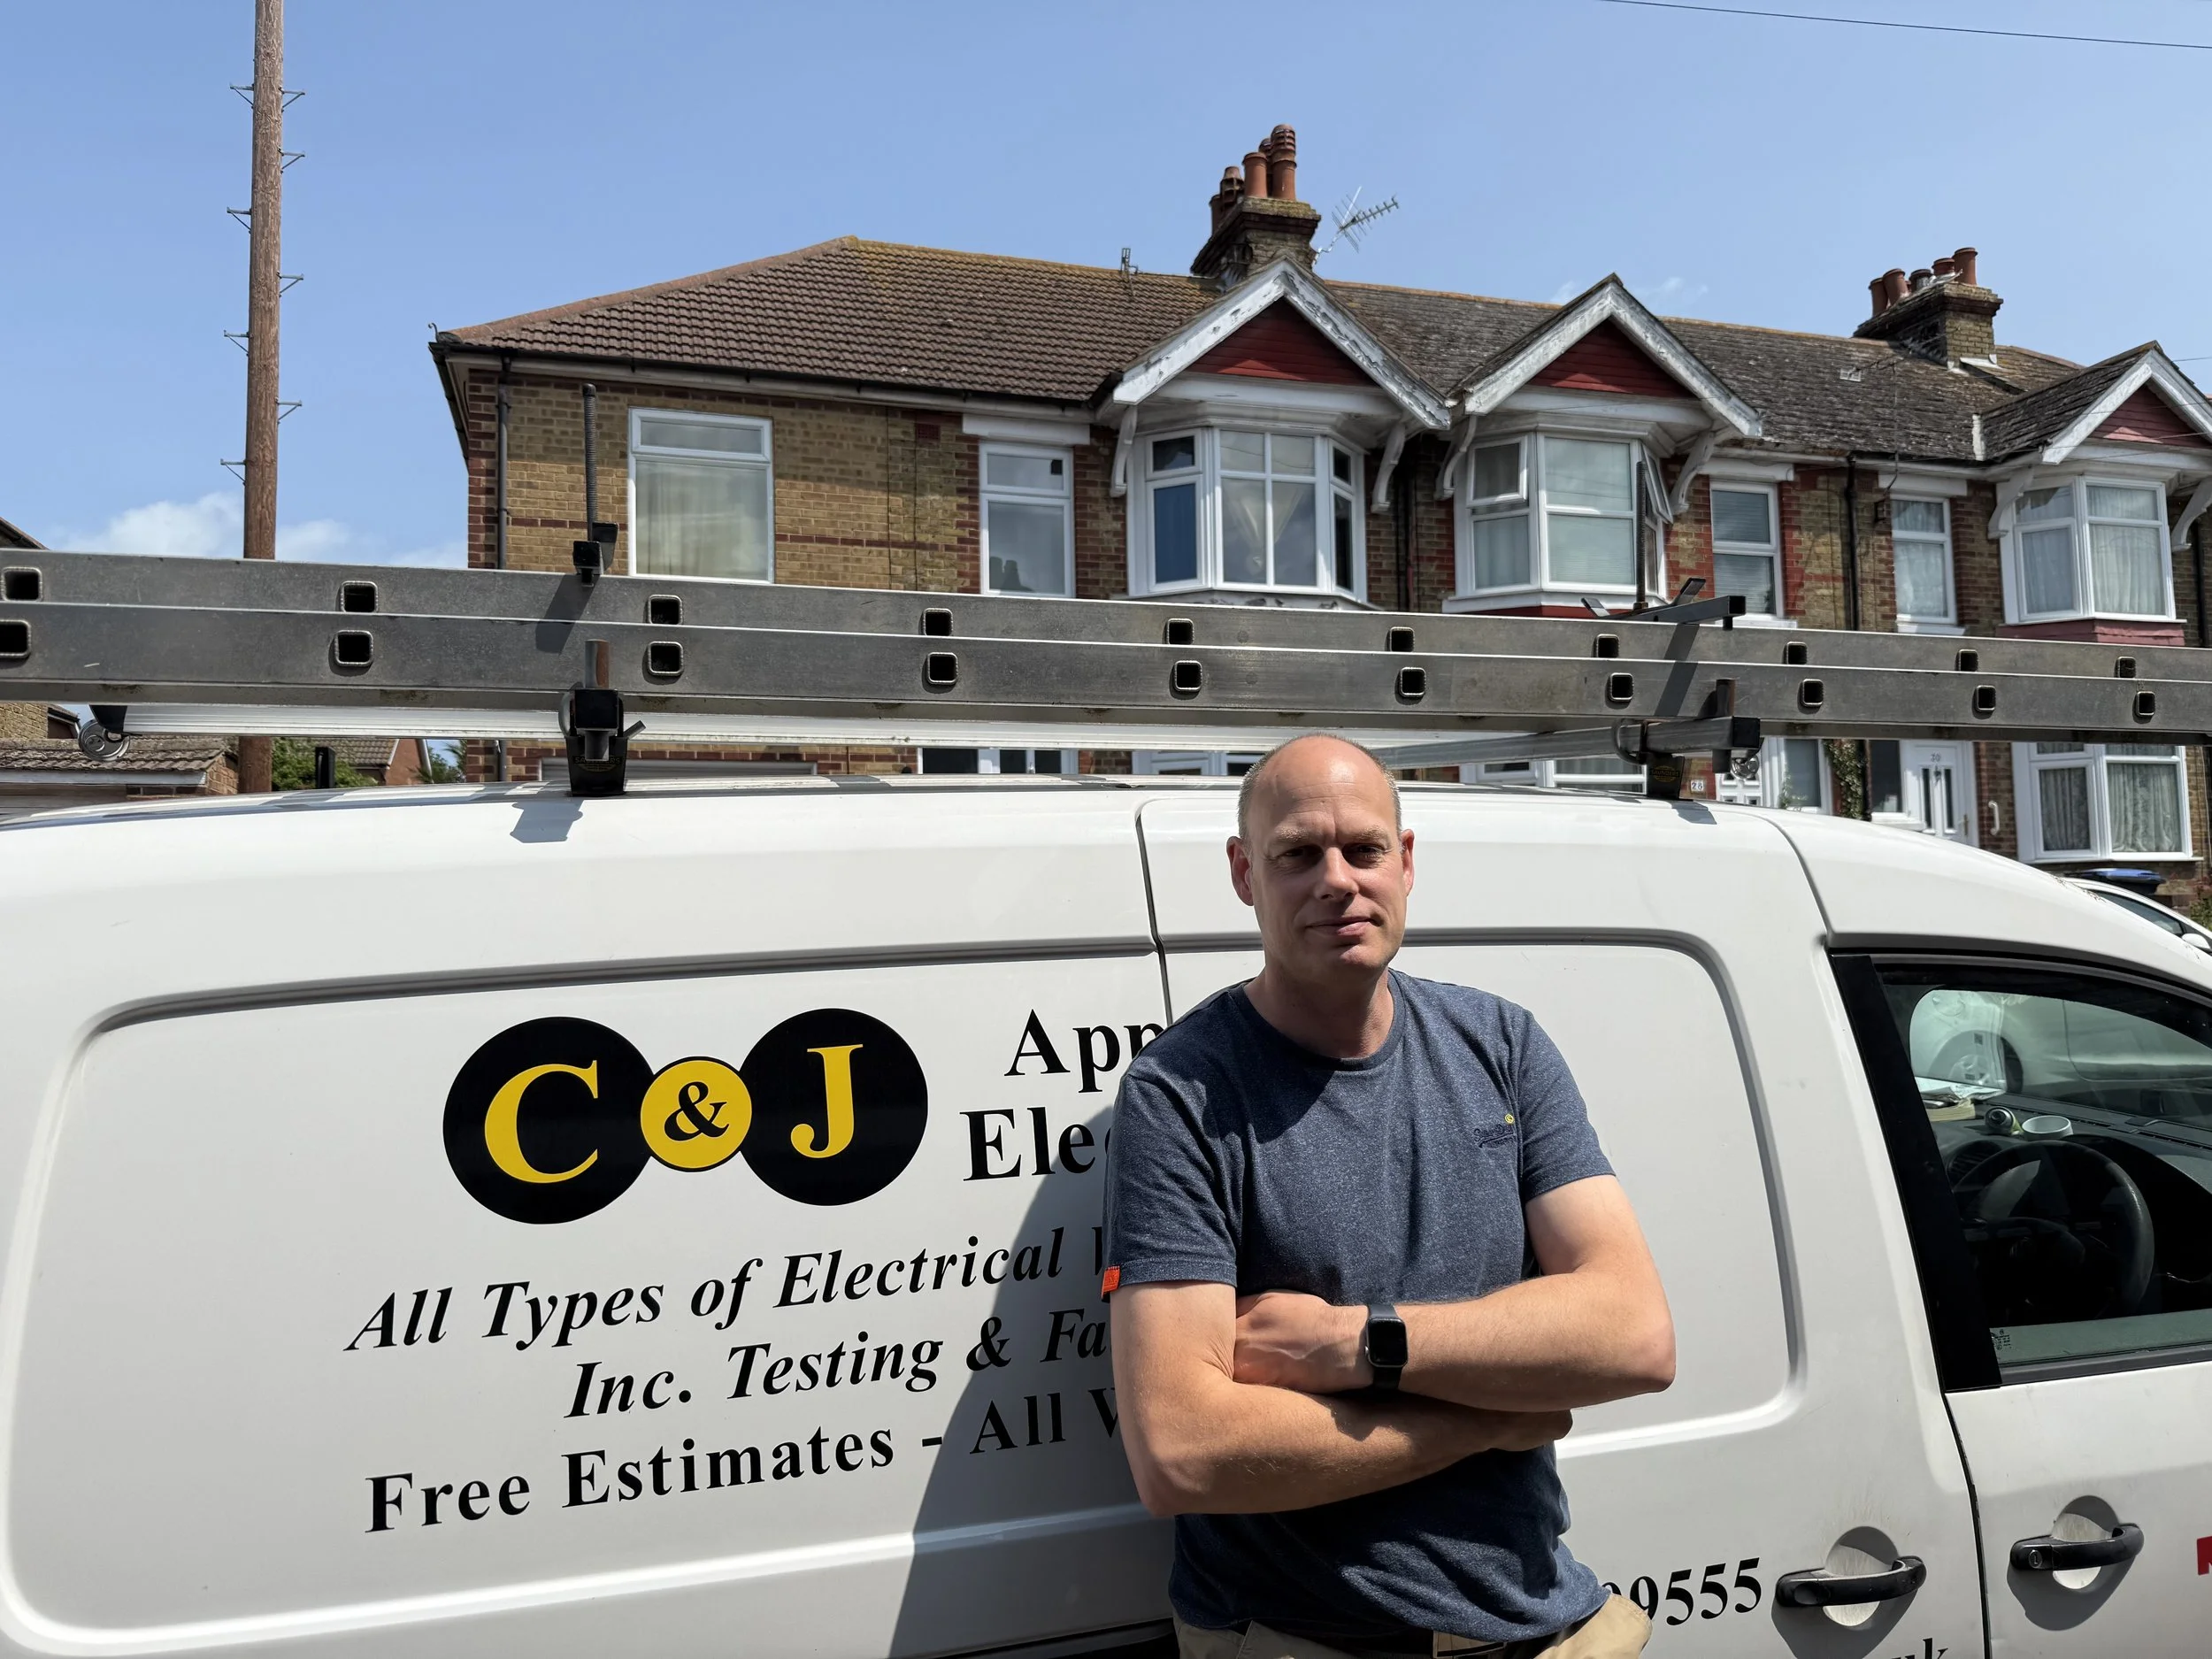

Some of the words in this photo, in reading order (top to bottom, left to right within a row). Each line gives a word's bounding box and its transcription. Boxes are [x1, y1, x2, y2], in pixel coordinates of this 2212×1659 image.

[484, 1061, 599, 1184] C
[664, 1081, 729, 1141] &
[790, 1045, 863, 1159] J
[960, 1107, 1112, 1182] Ele
[342, 1287, 453, 1351] All
[481, 1281, 664, 1351] Types
[690, 1257, 764, 1331] of
[772, 1226, 1064, 1309] Electrical
[564, 1361, 692, 1418] Inc.
[726, 1331, 944, 1400] Testing
[966, 1317, 1012, 1372] &
[1039, 1308, 1113, 1363] Fa
[365, 1472, 531, 1533] Free
[560, 1425, 895, 1509] Estimates
[921, 1435, 944, 1449] -
[969, 1392, 1067, 1455] All
